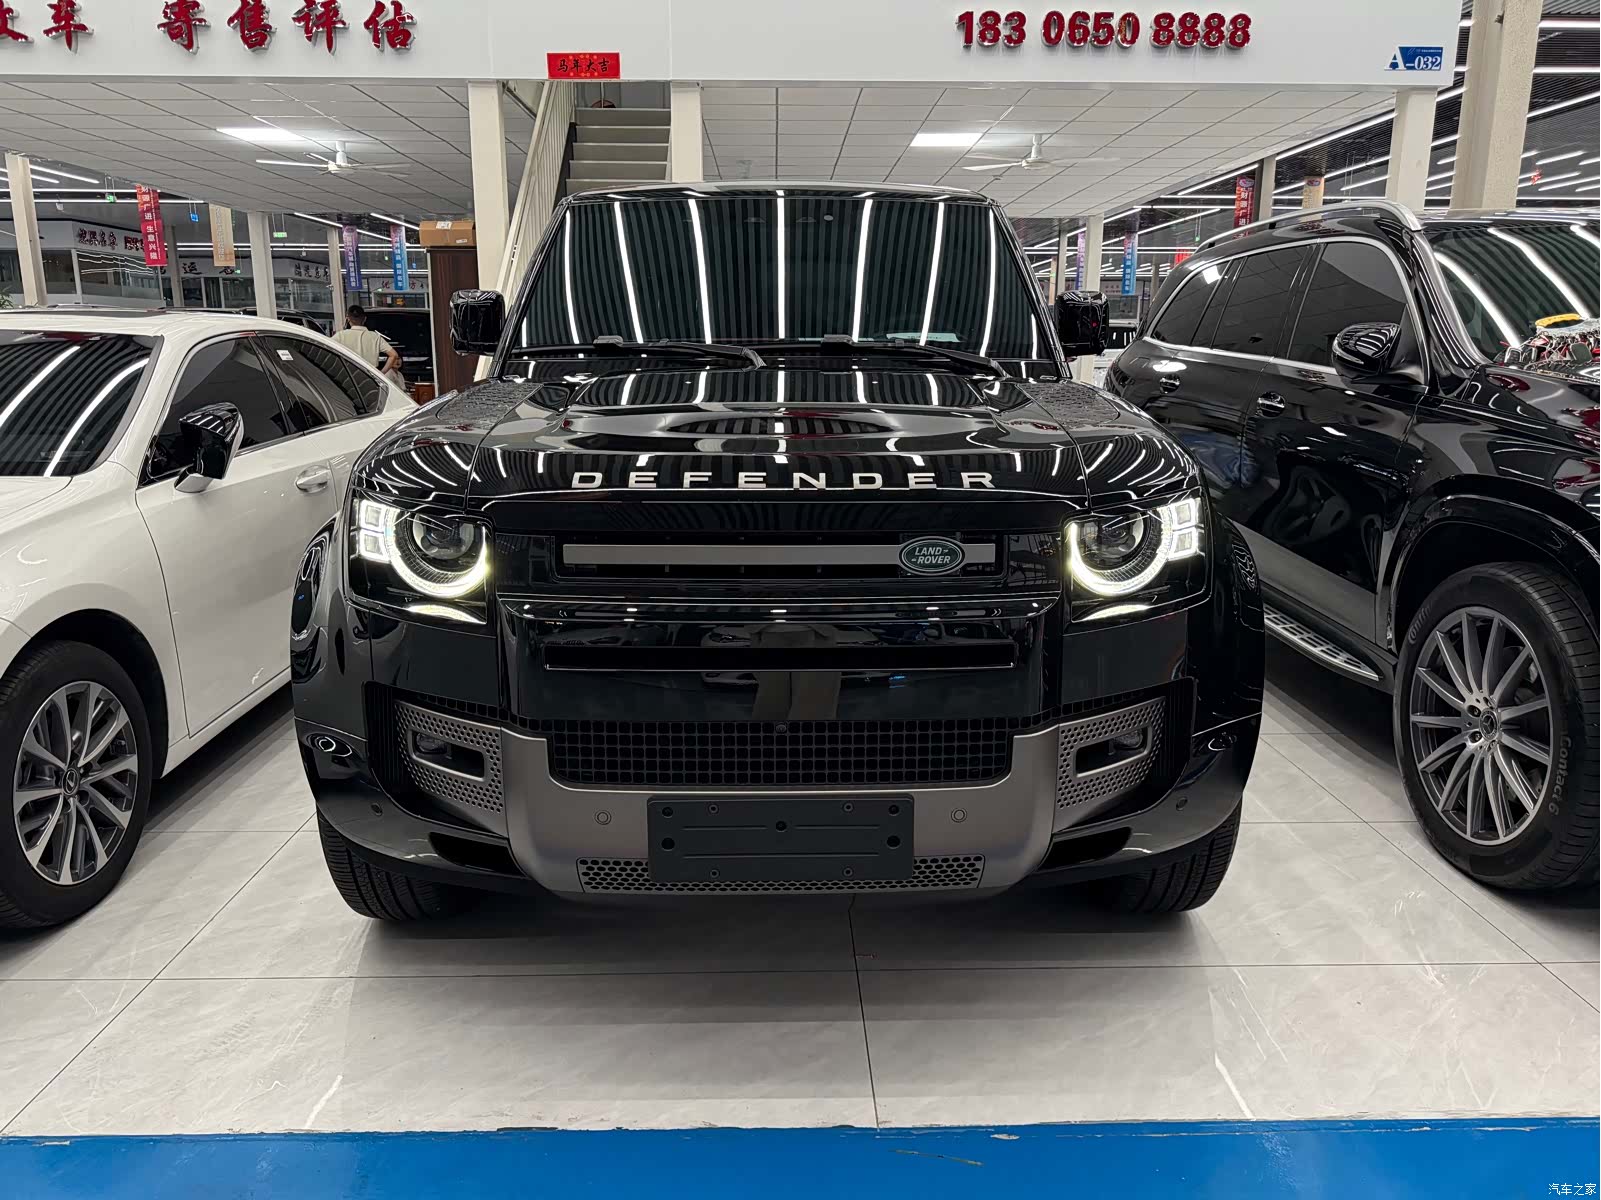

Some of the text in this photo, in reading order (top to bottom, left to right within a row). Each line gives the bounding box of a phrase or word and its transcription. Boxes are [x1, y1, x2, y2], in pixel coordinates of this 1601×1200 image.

[957, 10, 1252, 49] 183 0650 8888
[557, 58, 610, 72] 马年大吉
[571, 471, 996, 490] DEFENDER
[915, 546, 942, 556] LAND
[917, 555, 951, 565] ROVER
